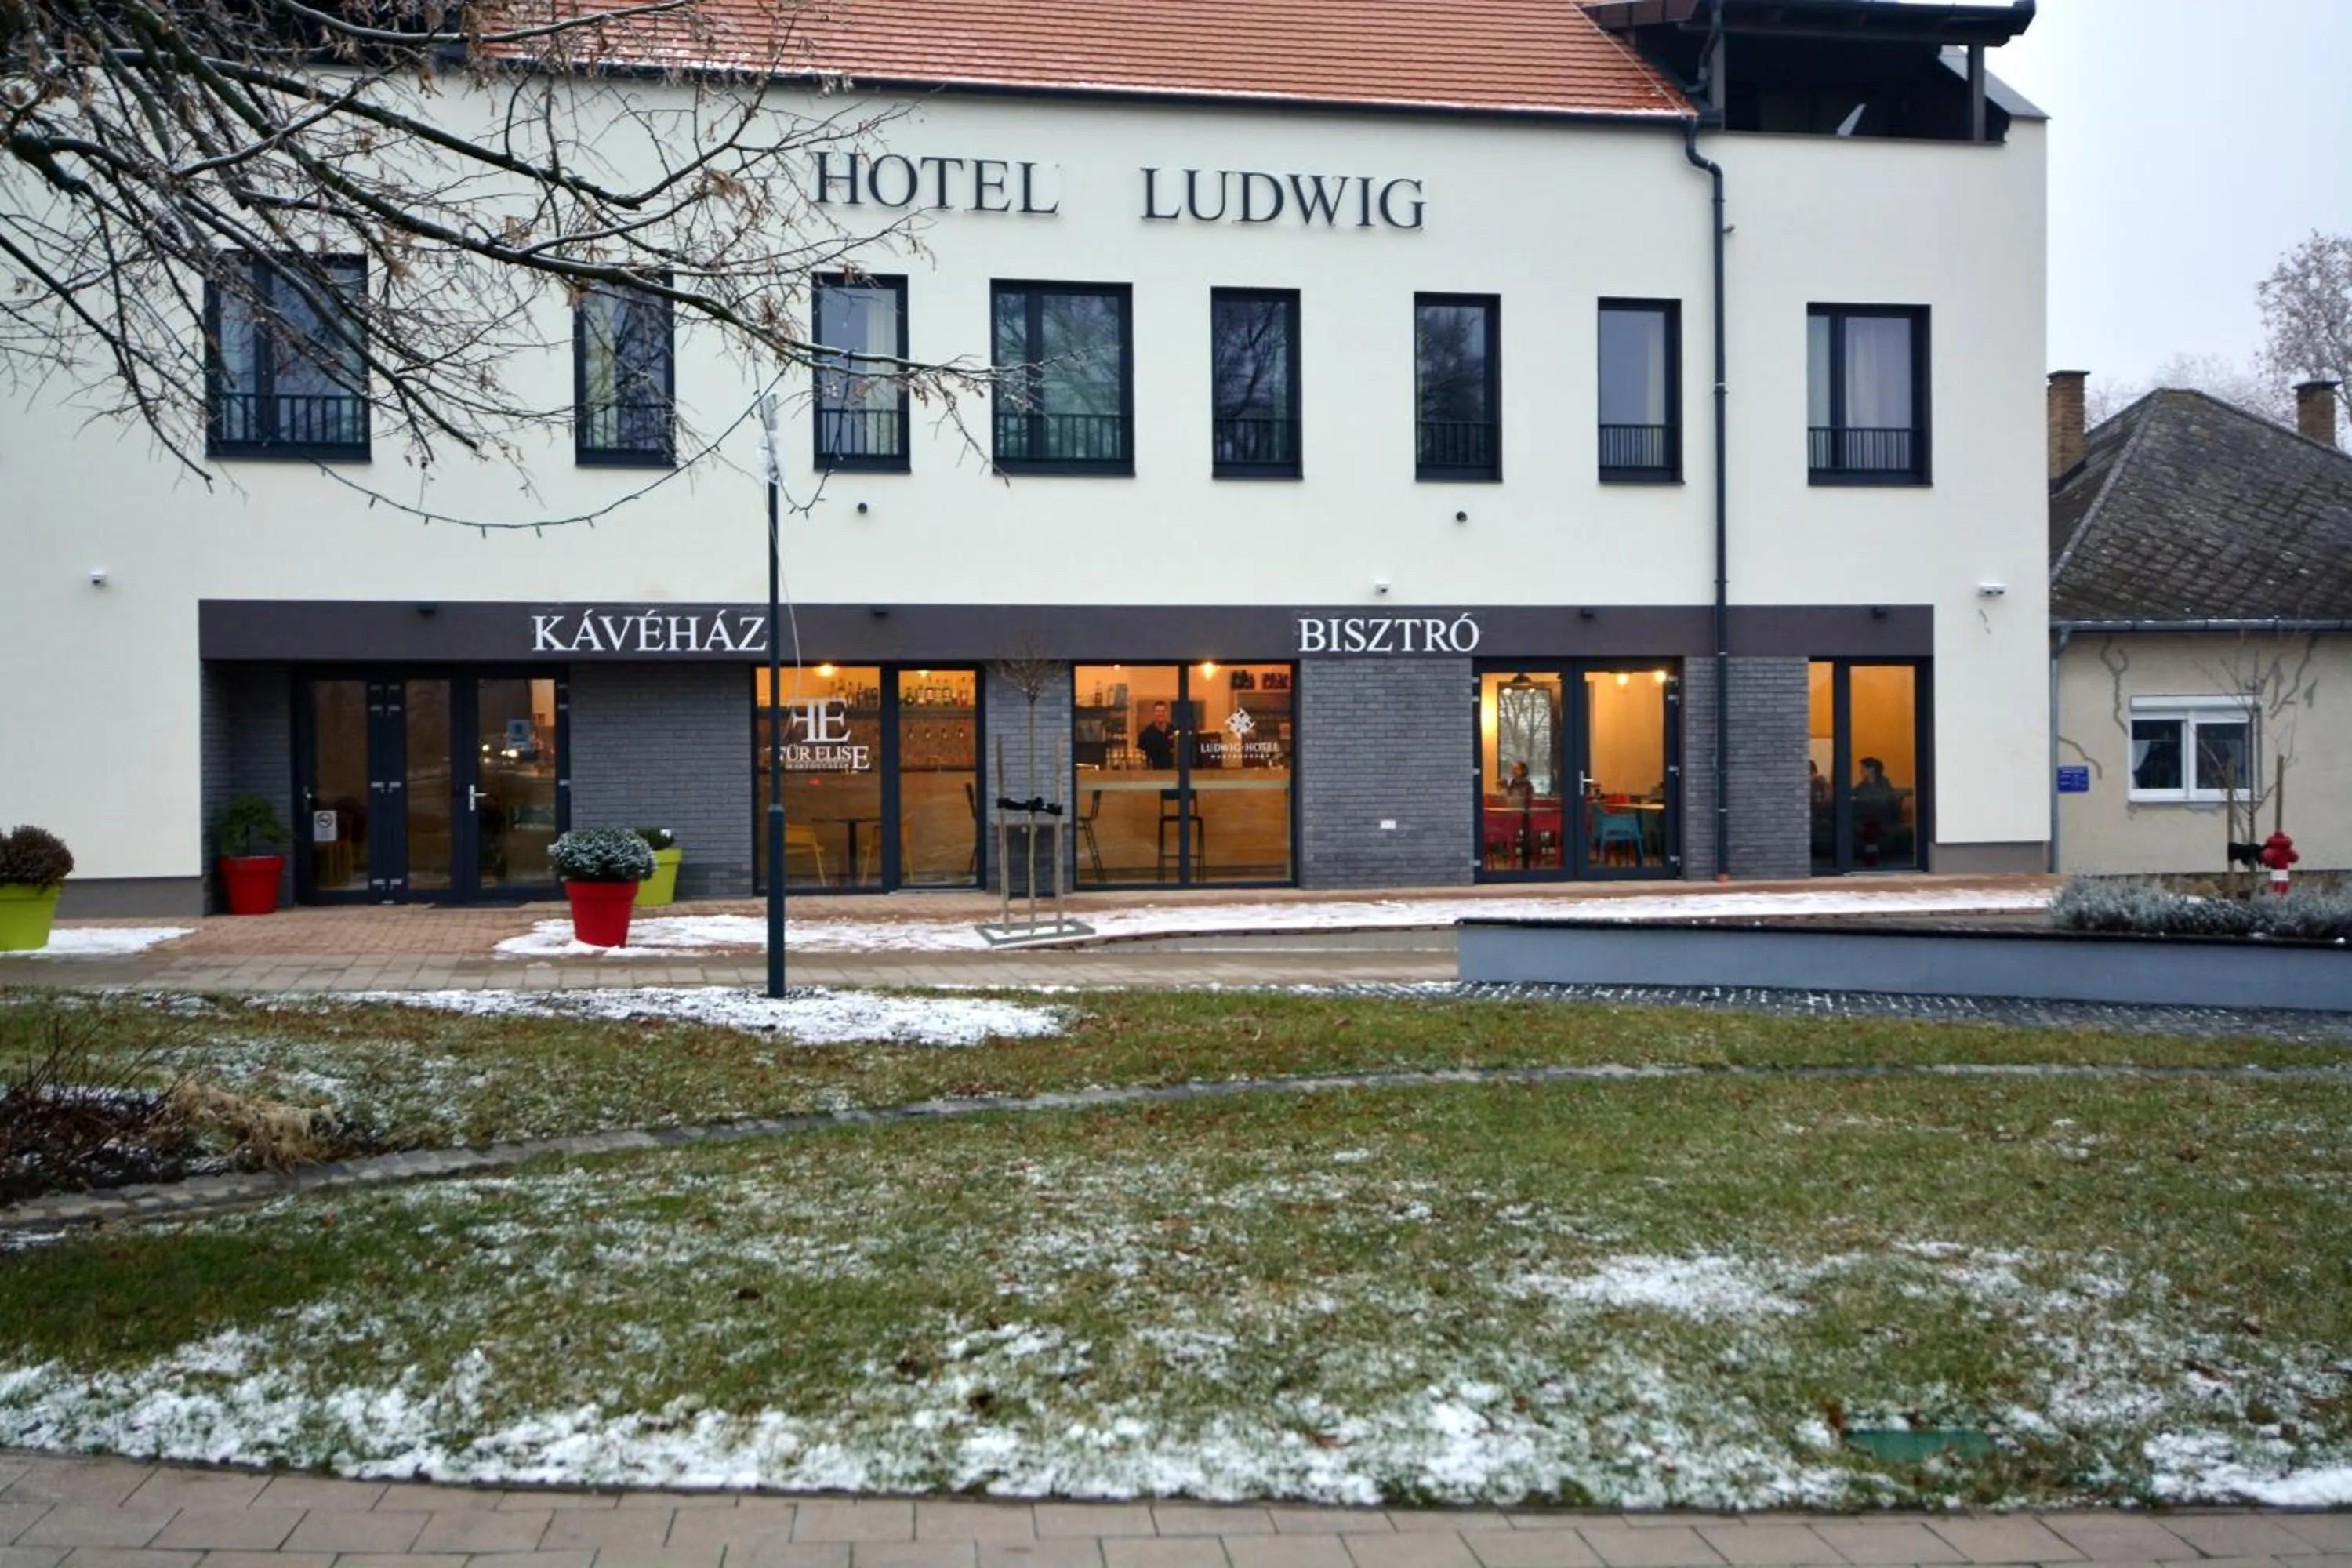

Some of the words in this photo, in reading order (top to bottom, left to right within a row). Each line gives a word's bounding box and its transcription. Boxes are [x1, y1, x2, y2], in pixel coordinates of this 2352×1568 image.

[814, 151, 1059, 214] HOTEL
[1139, 167, 1428, 229] LUDWIG
[531, 609, 768, 652] KÁVÉHÁZ
[1298, 612, 1480, 652] BISZTRÓ
[815, 746, 870, 769] ELISE
